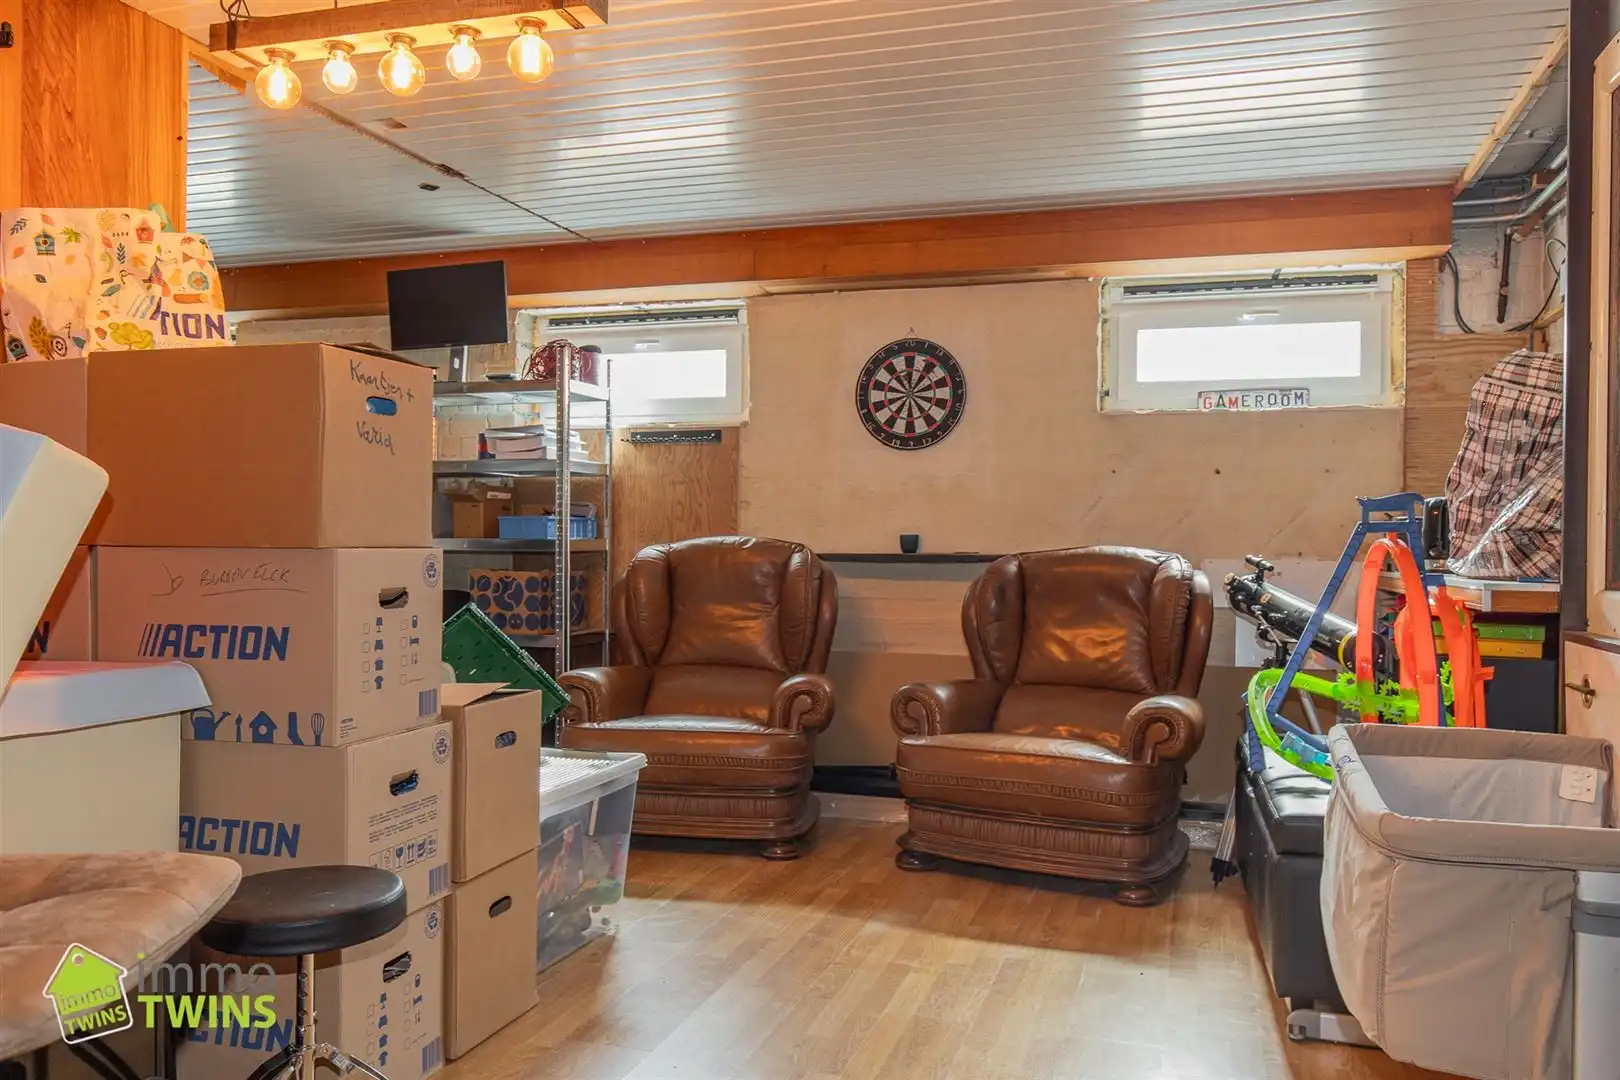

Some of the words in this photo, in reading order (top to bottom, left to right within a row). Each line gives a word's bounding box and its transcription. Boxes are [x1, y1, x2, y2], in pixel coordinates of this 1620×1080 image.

[1203, 391, 1304, 409] GAMEROOM
[157, 623, 290, 662] ACTION
[179, 815, 301, 858] ACTION
